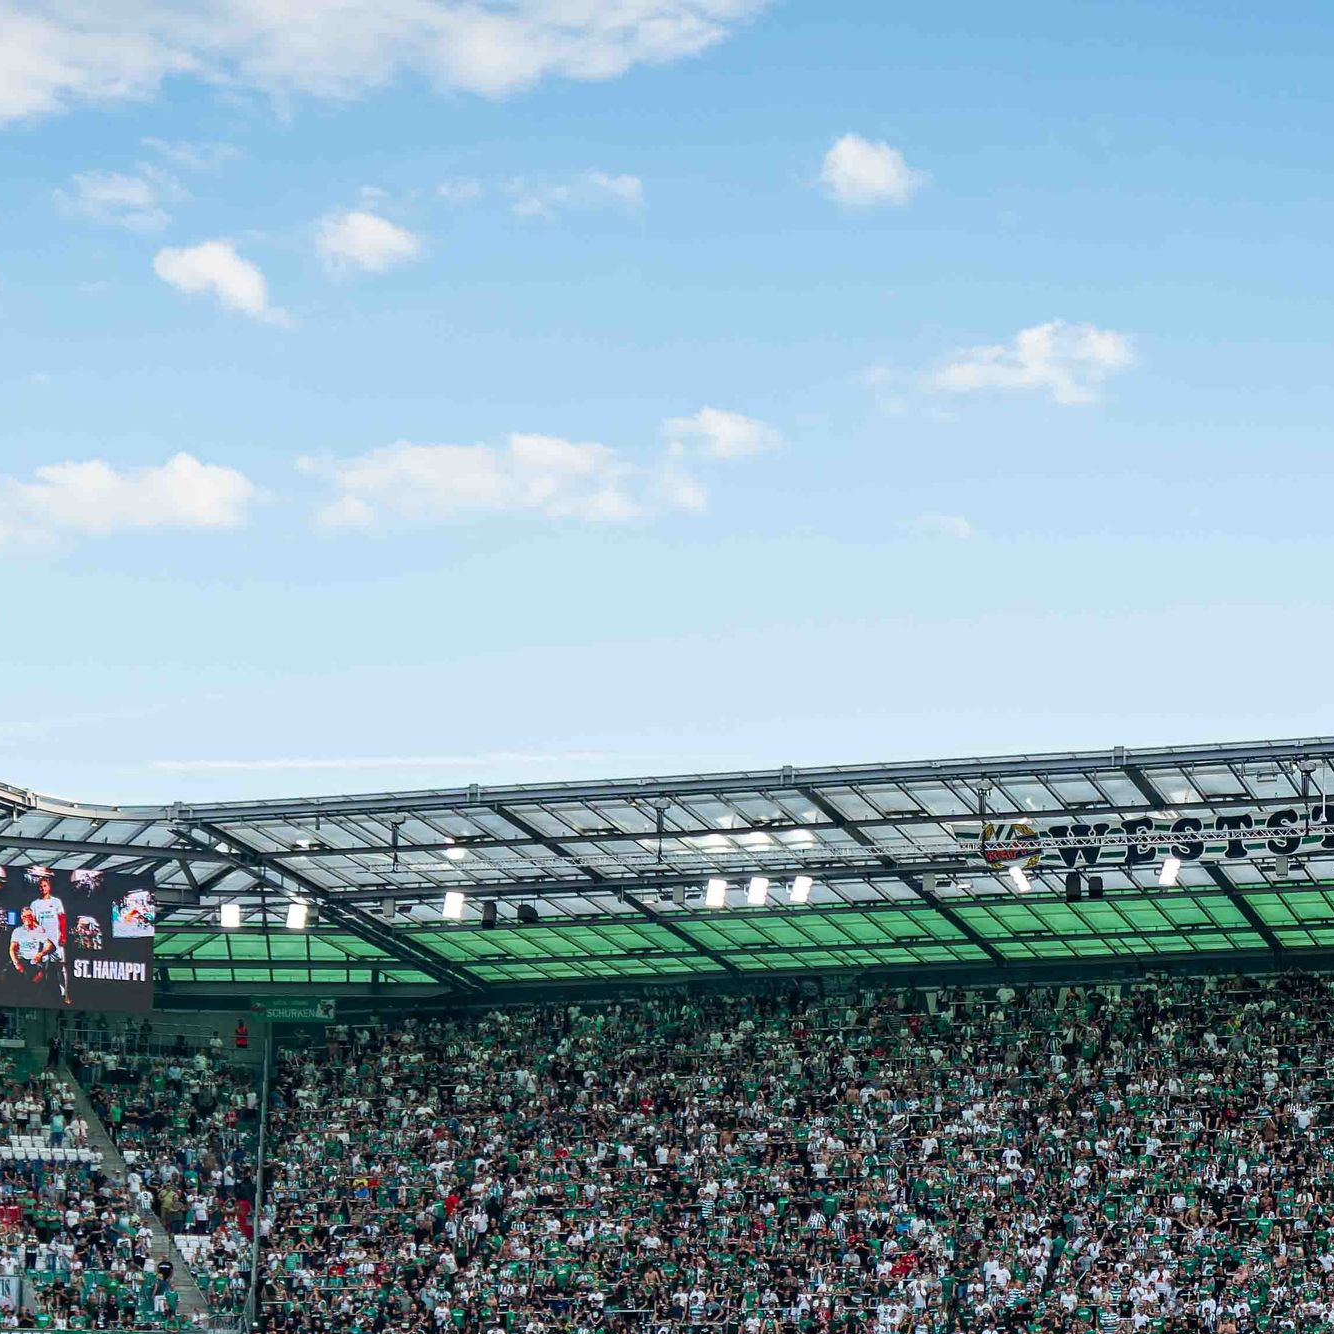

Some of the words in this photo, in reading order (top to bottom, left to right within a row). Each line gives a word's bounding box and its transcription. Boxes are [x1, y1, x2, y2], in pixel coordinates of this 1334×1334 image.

[73, 959, 92, 979] ST.
[92, 960, 146, 982] HANAPPI
[266, 1008, 315, 1018] SCHURKEN
